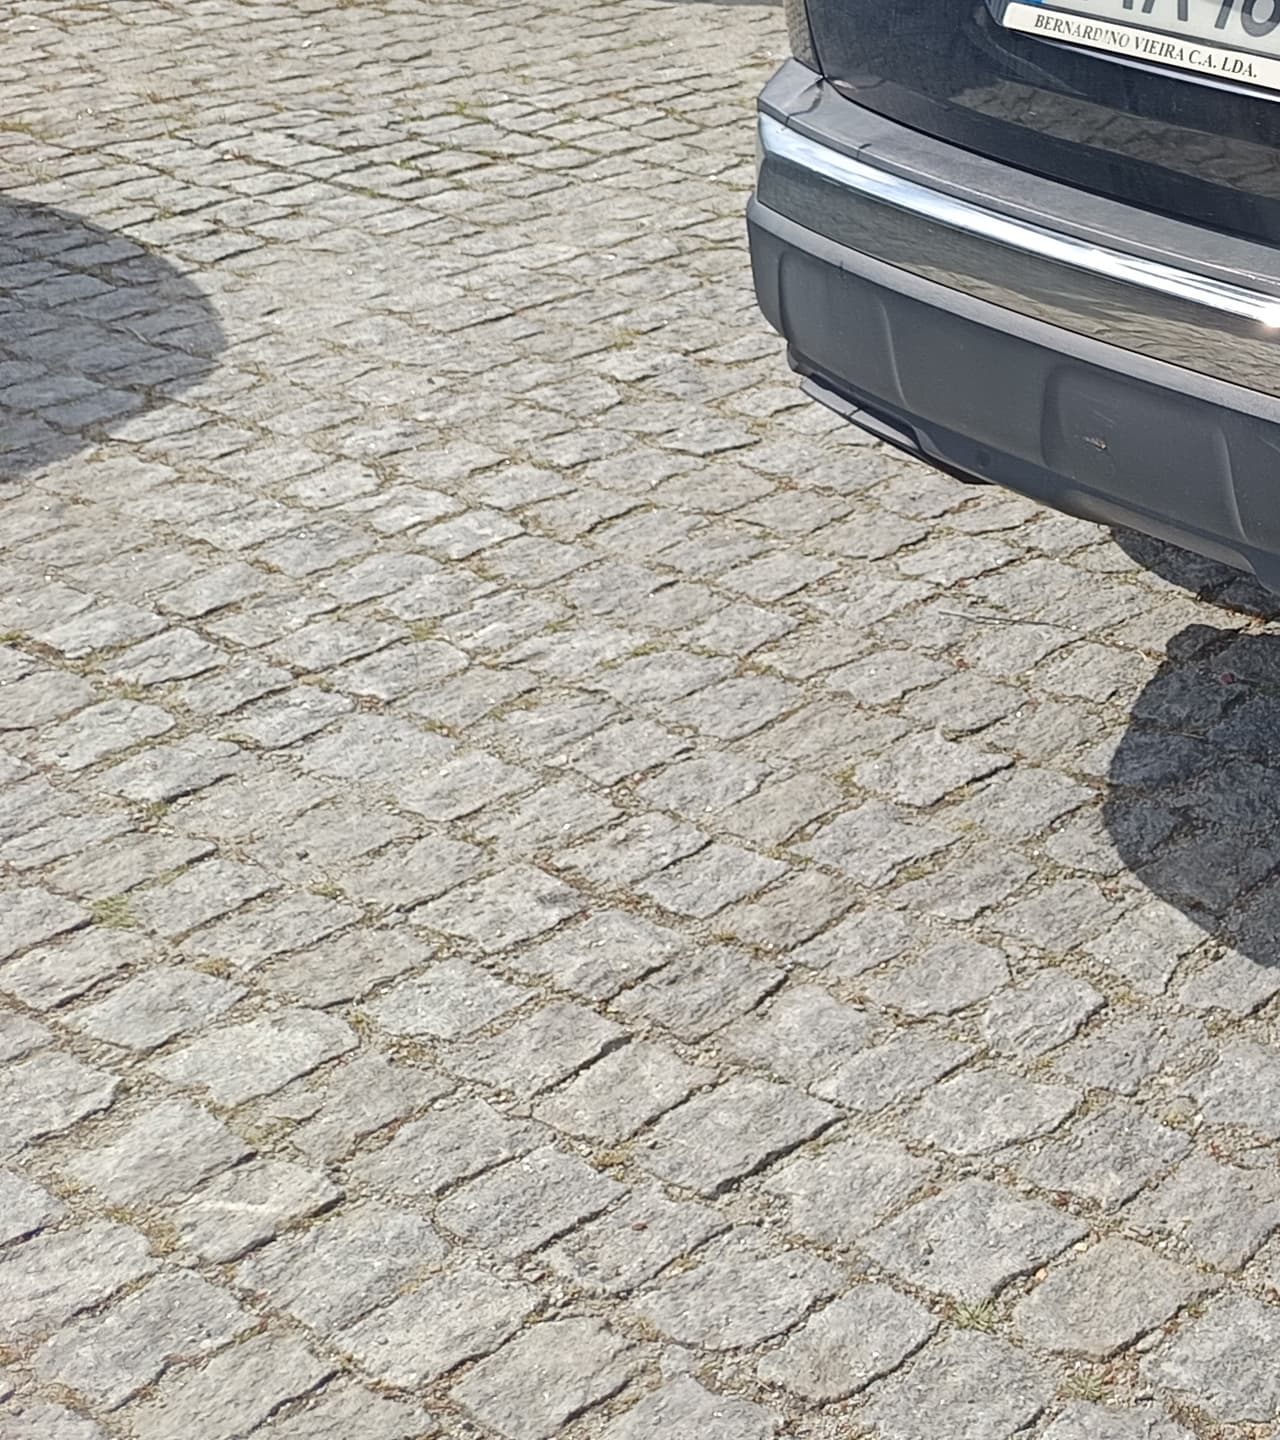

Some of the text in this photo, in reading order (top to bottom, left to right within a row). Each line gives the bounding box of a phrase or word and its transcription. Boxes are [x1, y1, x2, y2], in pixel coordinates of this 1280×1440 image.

[1034, 14, 1257, 78] BERNARDINO VIEIRA C.A. LDA.
